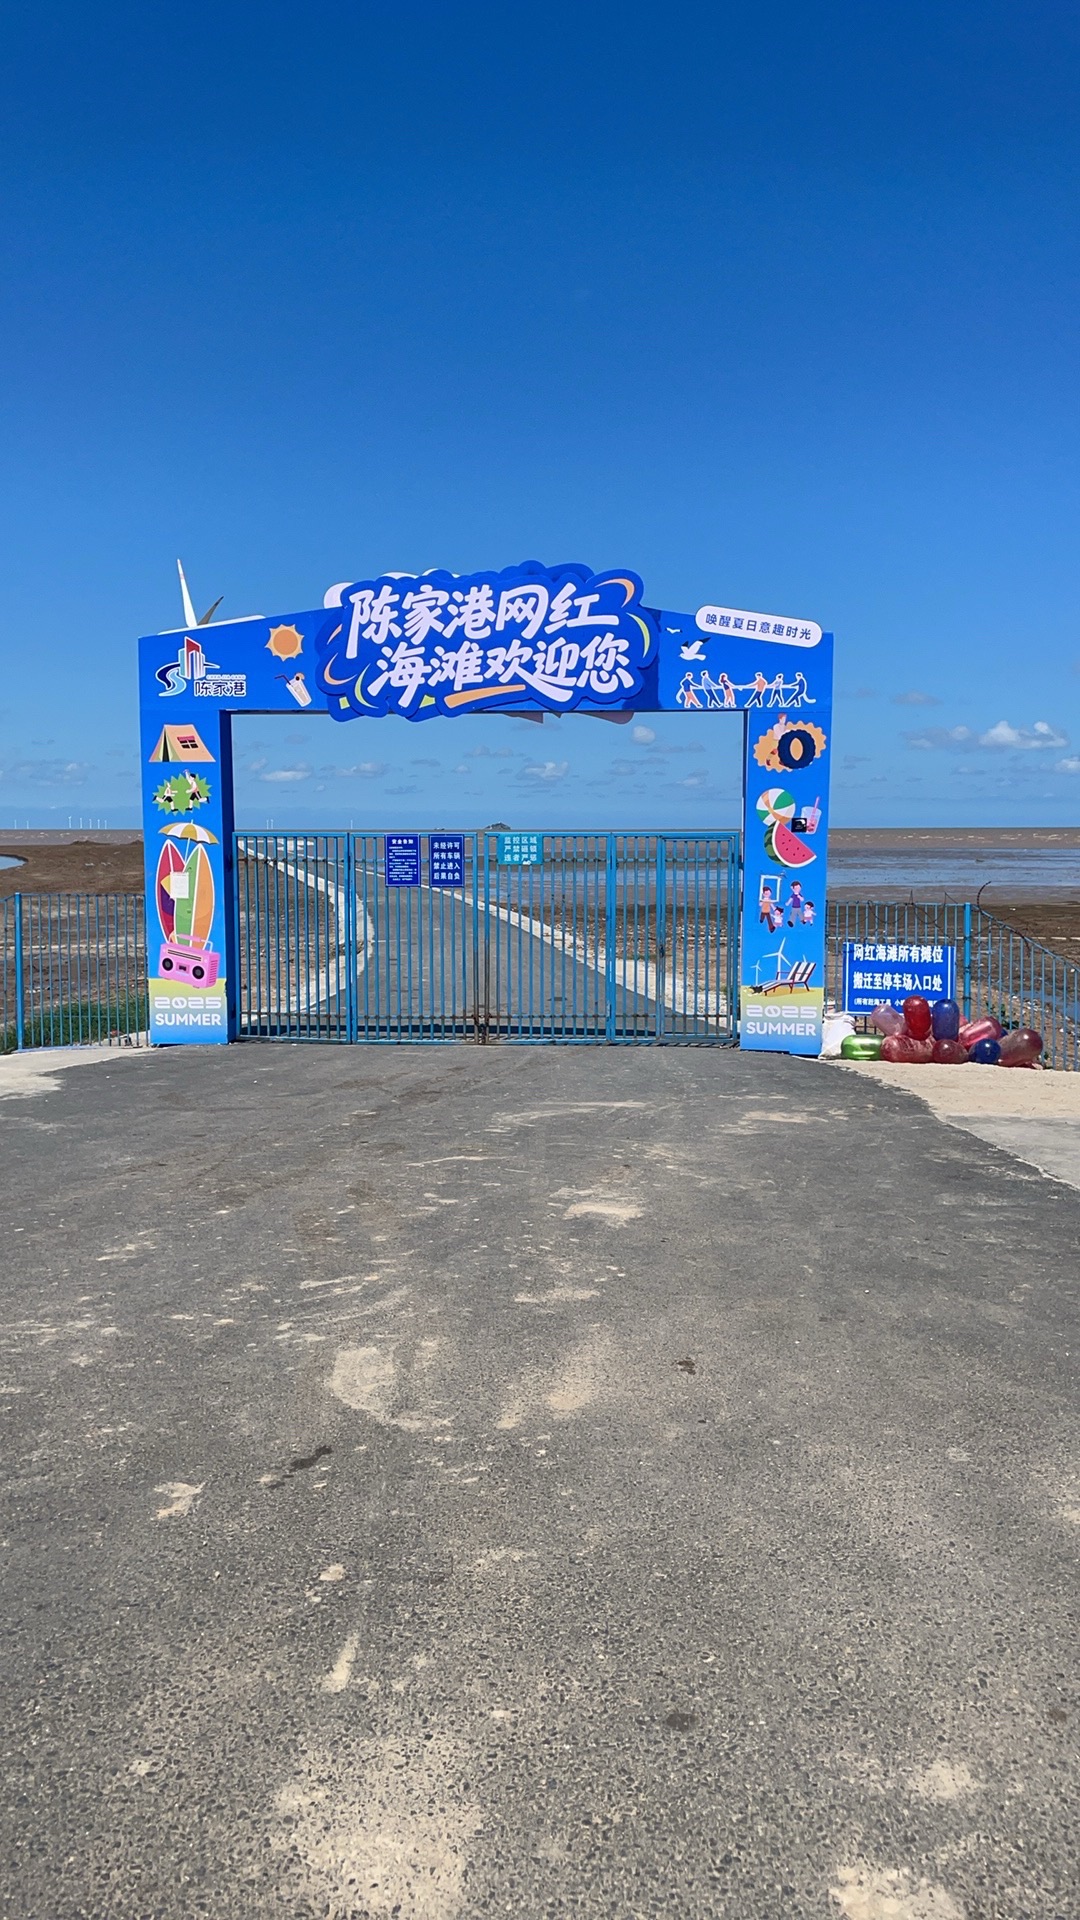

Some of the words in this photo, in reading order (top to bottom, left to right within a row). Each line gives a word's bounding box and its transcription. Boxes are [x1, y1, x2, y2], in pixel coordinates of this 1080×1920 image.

[346, 583, 619, 659] 陈家港网红
[705, 613, 811, 641] 唤醒夏日意趣时光
[367, 633, 634, 709] 海滩欢迎您
[194, 679, 247, 698] 陈家港
[433, 841, 460, 850] 未经许可
[433, 851, 460, 860] 所有车辆
[433, 861, 460, 870] 禁止进入
[433, 872, 460, 880] 后果自负
[853, 944, 944, 964] 网红海滩所有摊位
[853, 971, 943, 992] 搬迁至停车场入口处
[154, 996, 222, 1009] 2025
[155, 1013, 222, 1026] SUMMER
[746, 1005, 817, 1019] 2025
[746, 1021, 817, 1037] SUMMER
